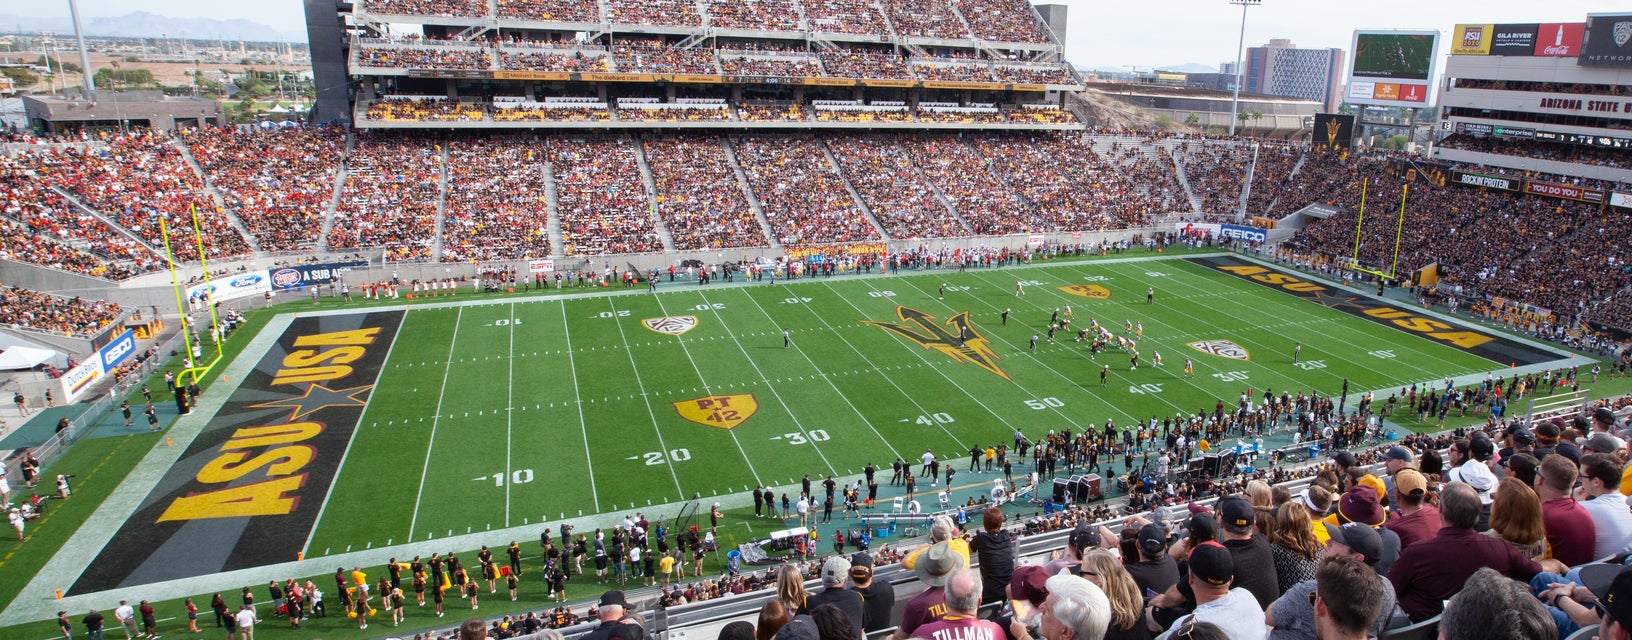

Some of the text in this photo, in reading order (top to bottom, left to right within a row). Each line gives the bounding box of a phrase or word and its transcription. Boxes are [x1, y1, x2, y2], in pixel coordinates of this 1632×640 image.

[1540, 98, 1582, 110] ARIZONA
[1587, 101, 1619, 112] STATE
[1484, 177, 1510, 189] PROTEIN
[1532, 184, 1547, 192] YOU
[1548, 186, 1560, 194] DO
[1562, 188, 1578, 197] YOU
[1221, 228, 1265, 242] GEICO
[303, 270, 310, 281] A
[311, 269, 330, 280] SUB
[1216, 265, 1328, 293] ASU
[600, 310, 632, 318] 20
[695, 303, 727, 311] 30
[1361, 308, 1496, 349] USA
[104, 337, 132, 365] GEICO
[270, 327, 383, 386] USA
[1212, 371, 1249, 382] 30
[1129, 383, 1163, 394] 40
[696, 396, 731, 409] PT
[1024, 397, 1065, 411] 50
[705, 410, 741, 423] 42
[915, 412, 955, 426] 40
[785, 429, 831, 445] 30
[643, 448, 691, 466] 20
[155, 421, 327, 524] ASU
[492, 468, 534, 487] 10
[932, 626, 993, 640] TILLMAN
